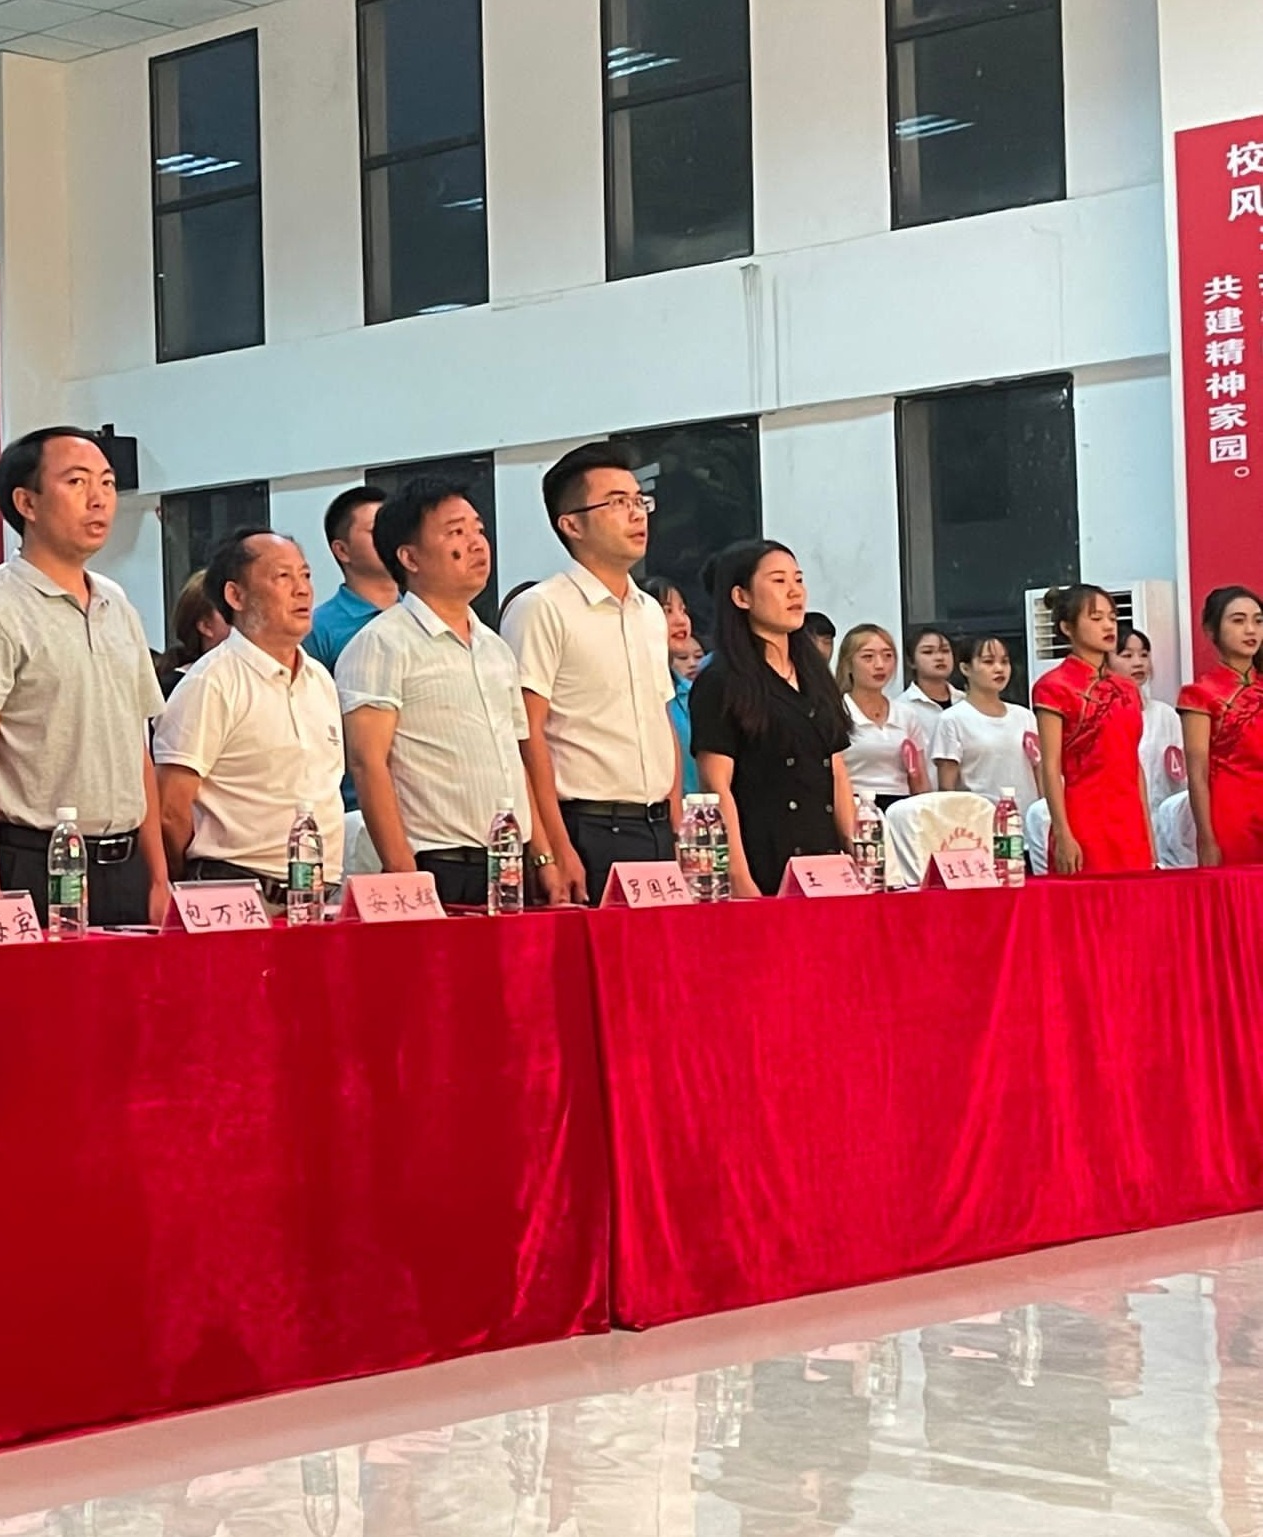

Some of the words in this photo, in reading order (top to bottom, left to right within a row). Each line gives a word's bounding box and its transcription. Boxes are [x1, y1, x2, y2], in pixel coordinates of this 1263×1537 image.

[1203, 275, 1250, 478] 共建精神家园。
[1171, 750, 1182, 776] 4
[186, 900, 265, 927] 包万洪
